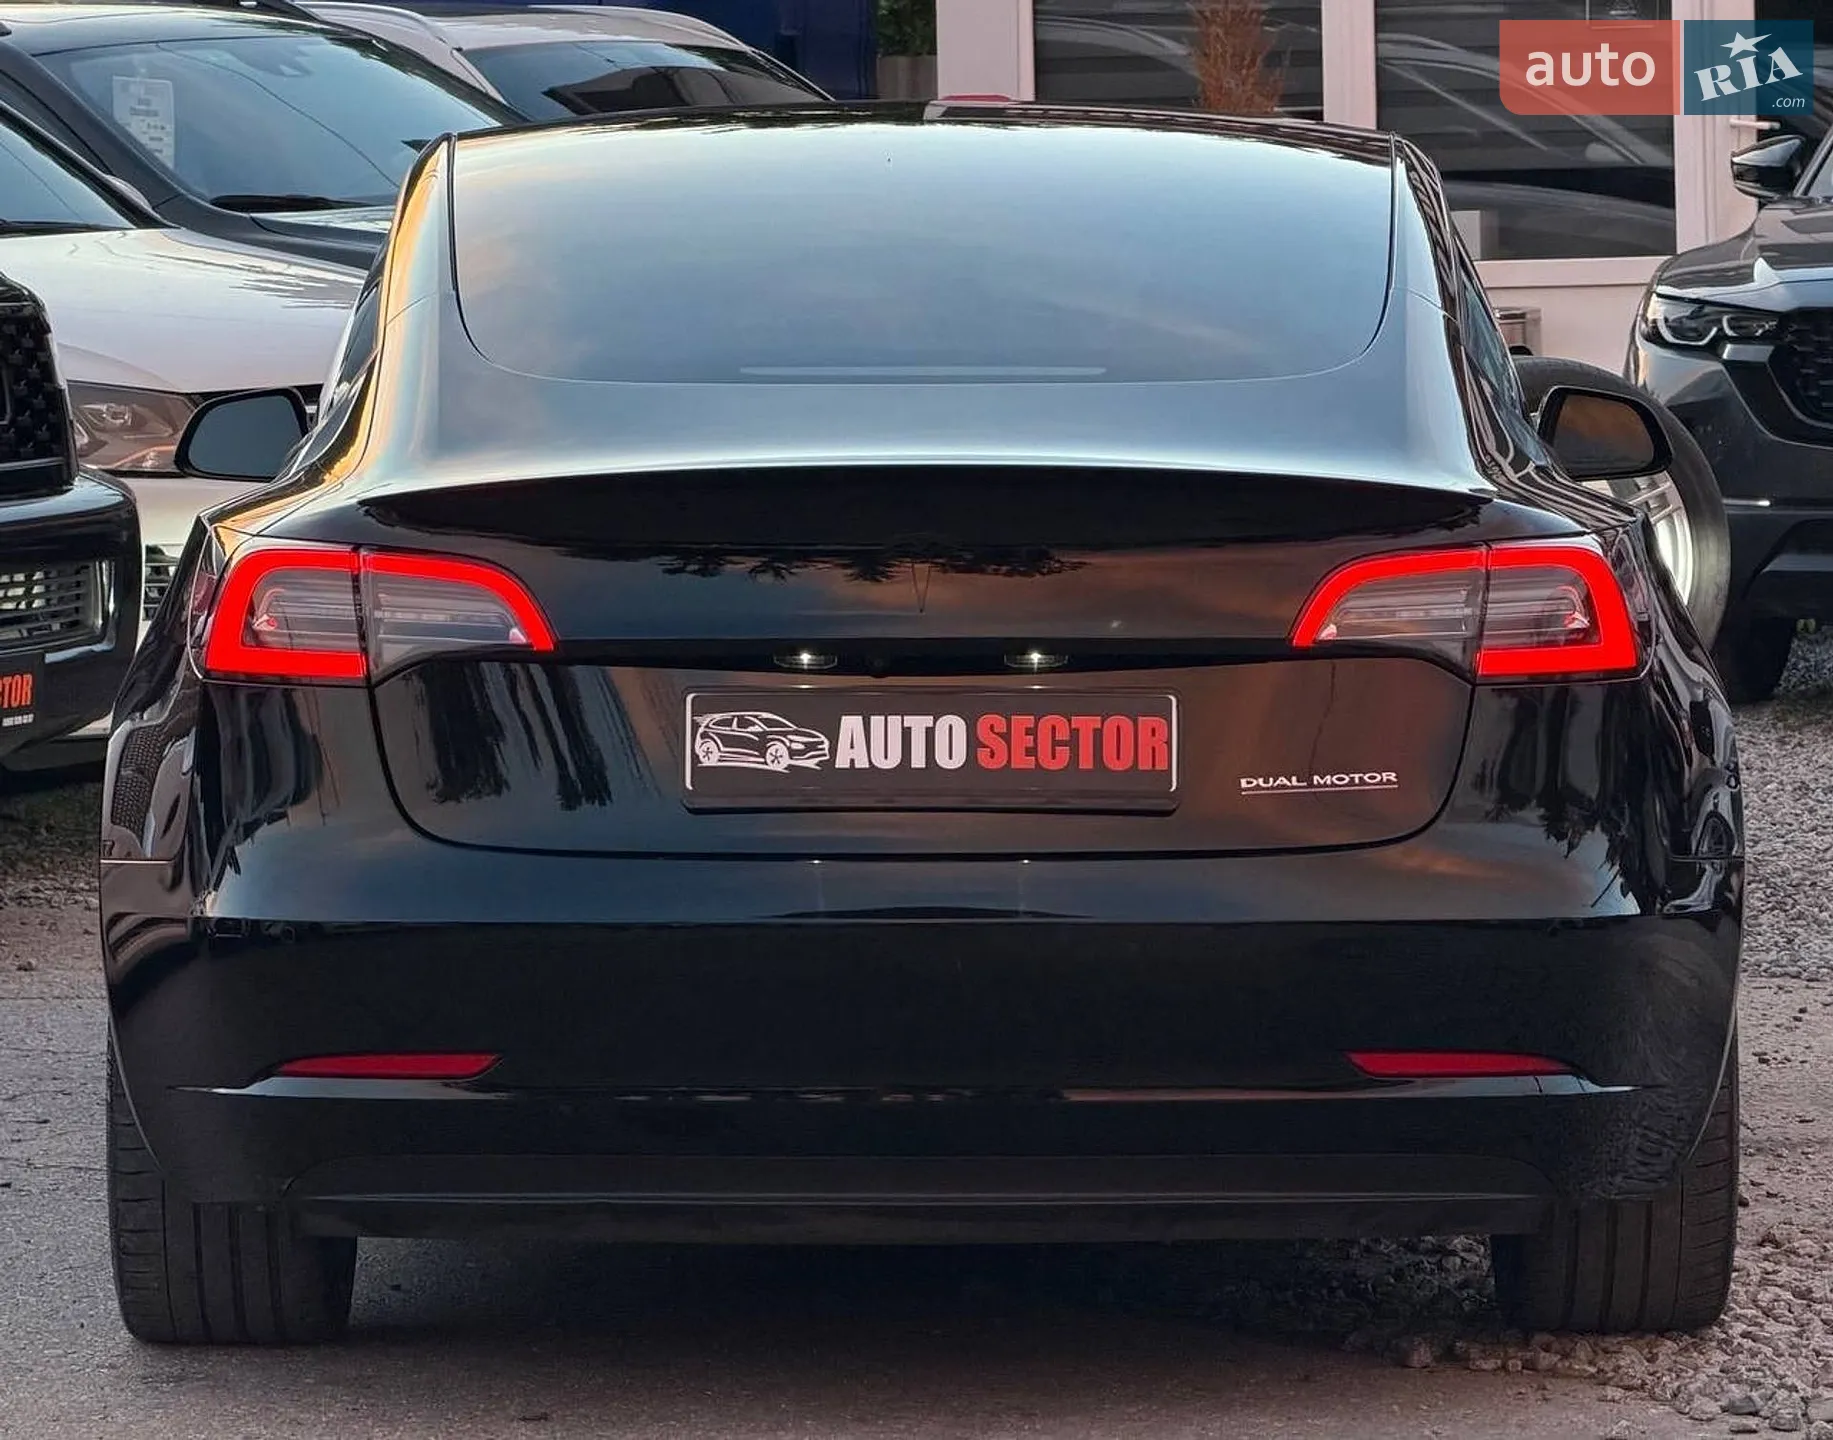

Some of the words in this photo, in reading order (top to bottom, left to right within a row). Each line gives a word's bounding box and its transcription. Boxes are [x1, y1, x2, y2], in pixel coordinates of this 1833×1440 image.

[0, 673, 33, 709] TOR
[834, 714, 968, 770] AUTO
[975, 713, 1169, 771] SECTOR
[1239, 775, 1308, 789] DUAL
[1312, 771, 1399, 786] MOTOR
